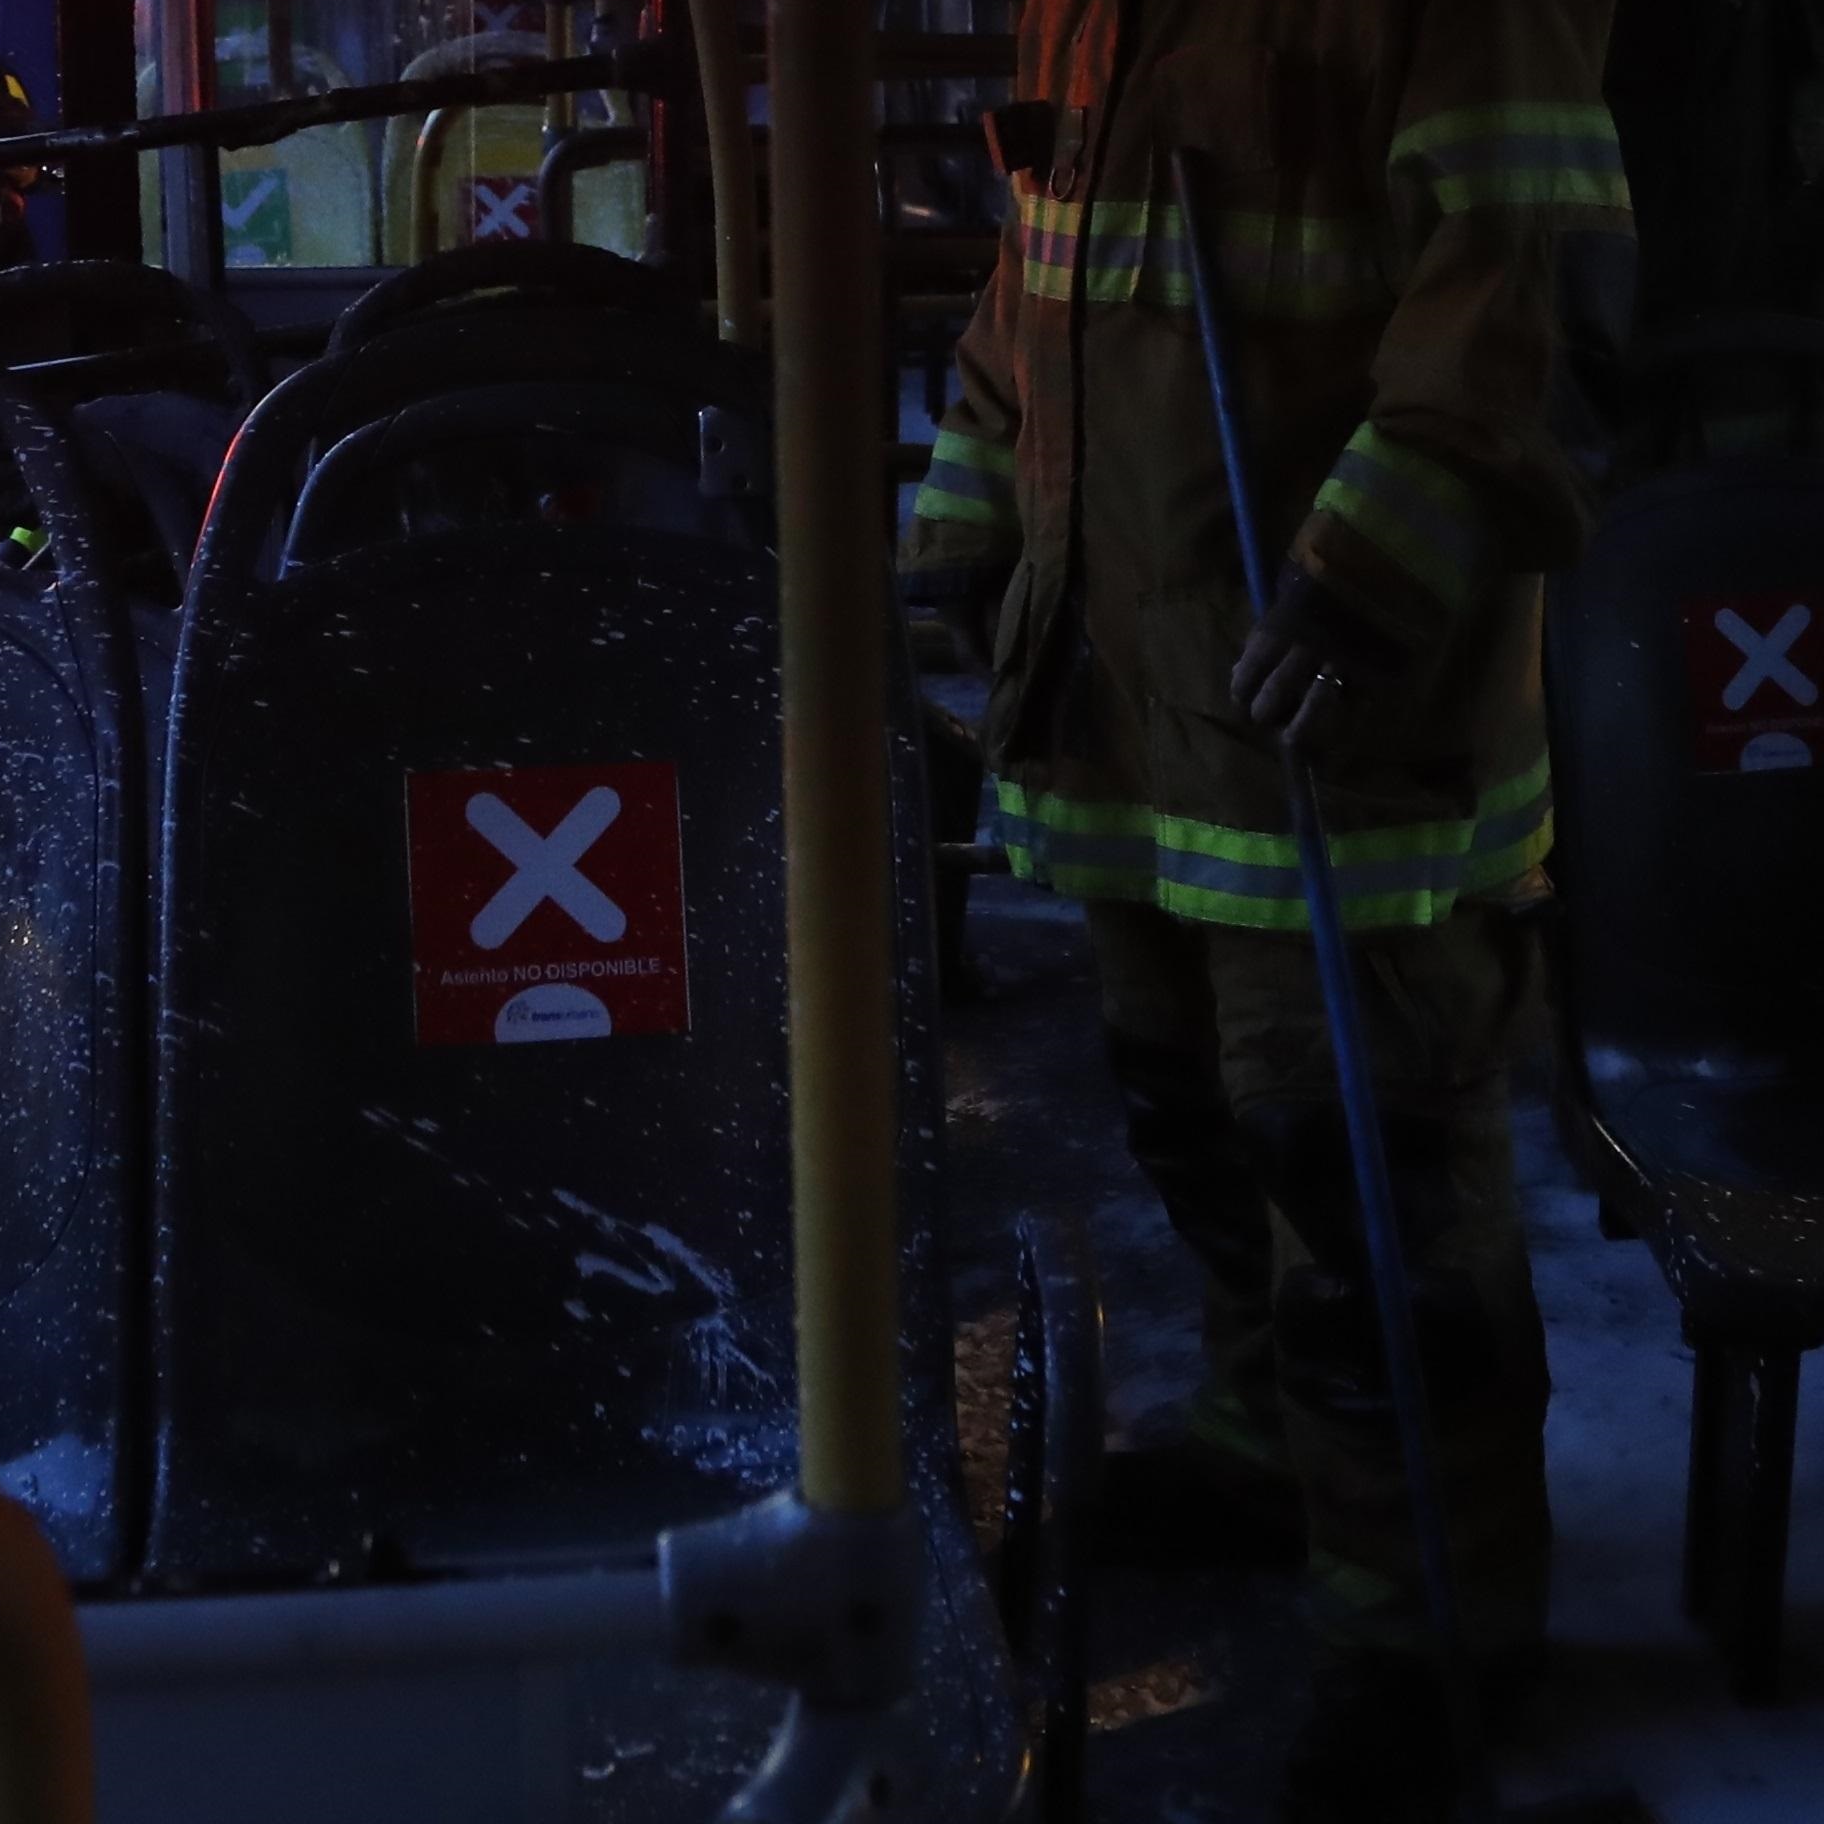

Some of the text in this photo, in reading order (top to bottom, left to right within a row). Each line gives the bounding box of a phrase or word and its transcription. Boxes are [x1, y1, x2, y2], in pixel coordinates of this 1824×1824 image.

[440, 957, 662, 986] Asiento NO DISPONIBLE
